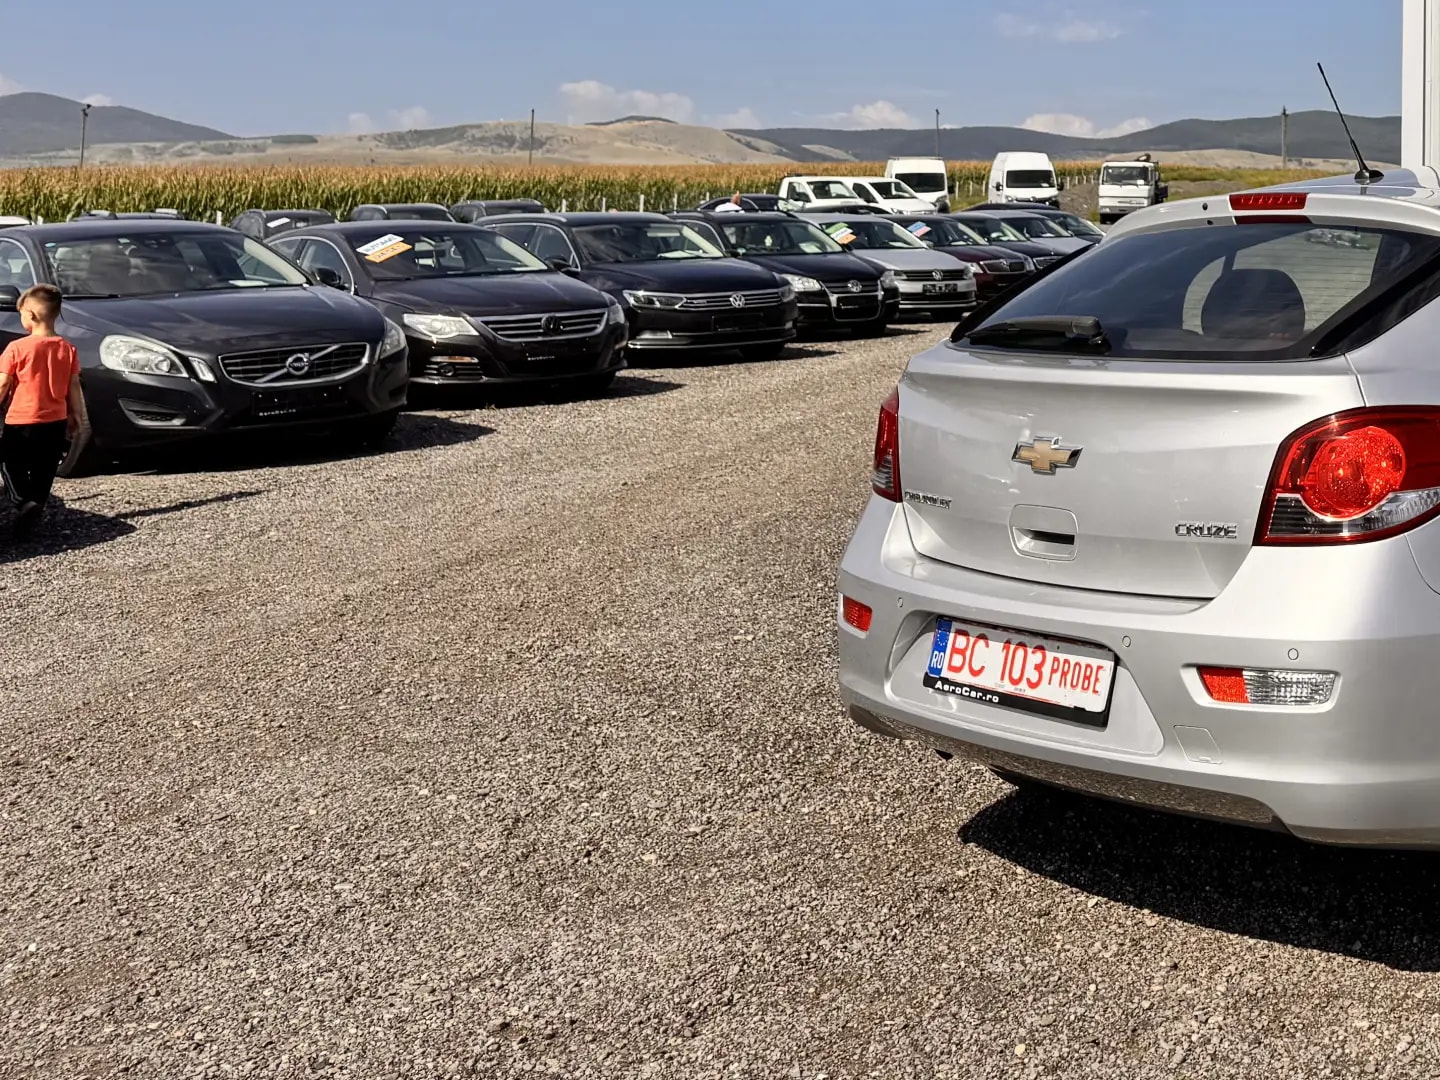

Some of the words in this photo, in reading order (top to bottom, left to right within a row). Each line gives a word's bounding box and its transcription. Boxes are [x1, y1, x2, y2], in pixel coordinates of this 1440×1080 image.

[1174, 522, 1237, 539] CRUZE
[931, 650, 945, 669] RO
[946, 628, 990, 678] BC
[999, 638, 1048, 690] 103
[1048, 656, 1105, 696] PROBE
[934, 680, 1000, 703] AeroCar.ro
